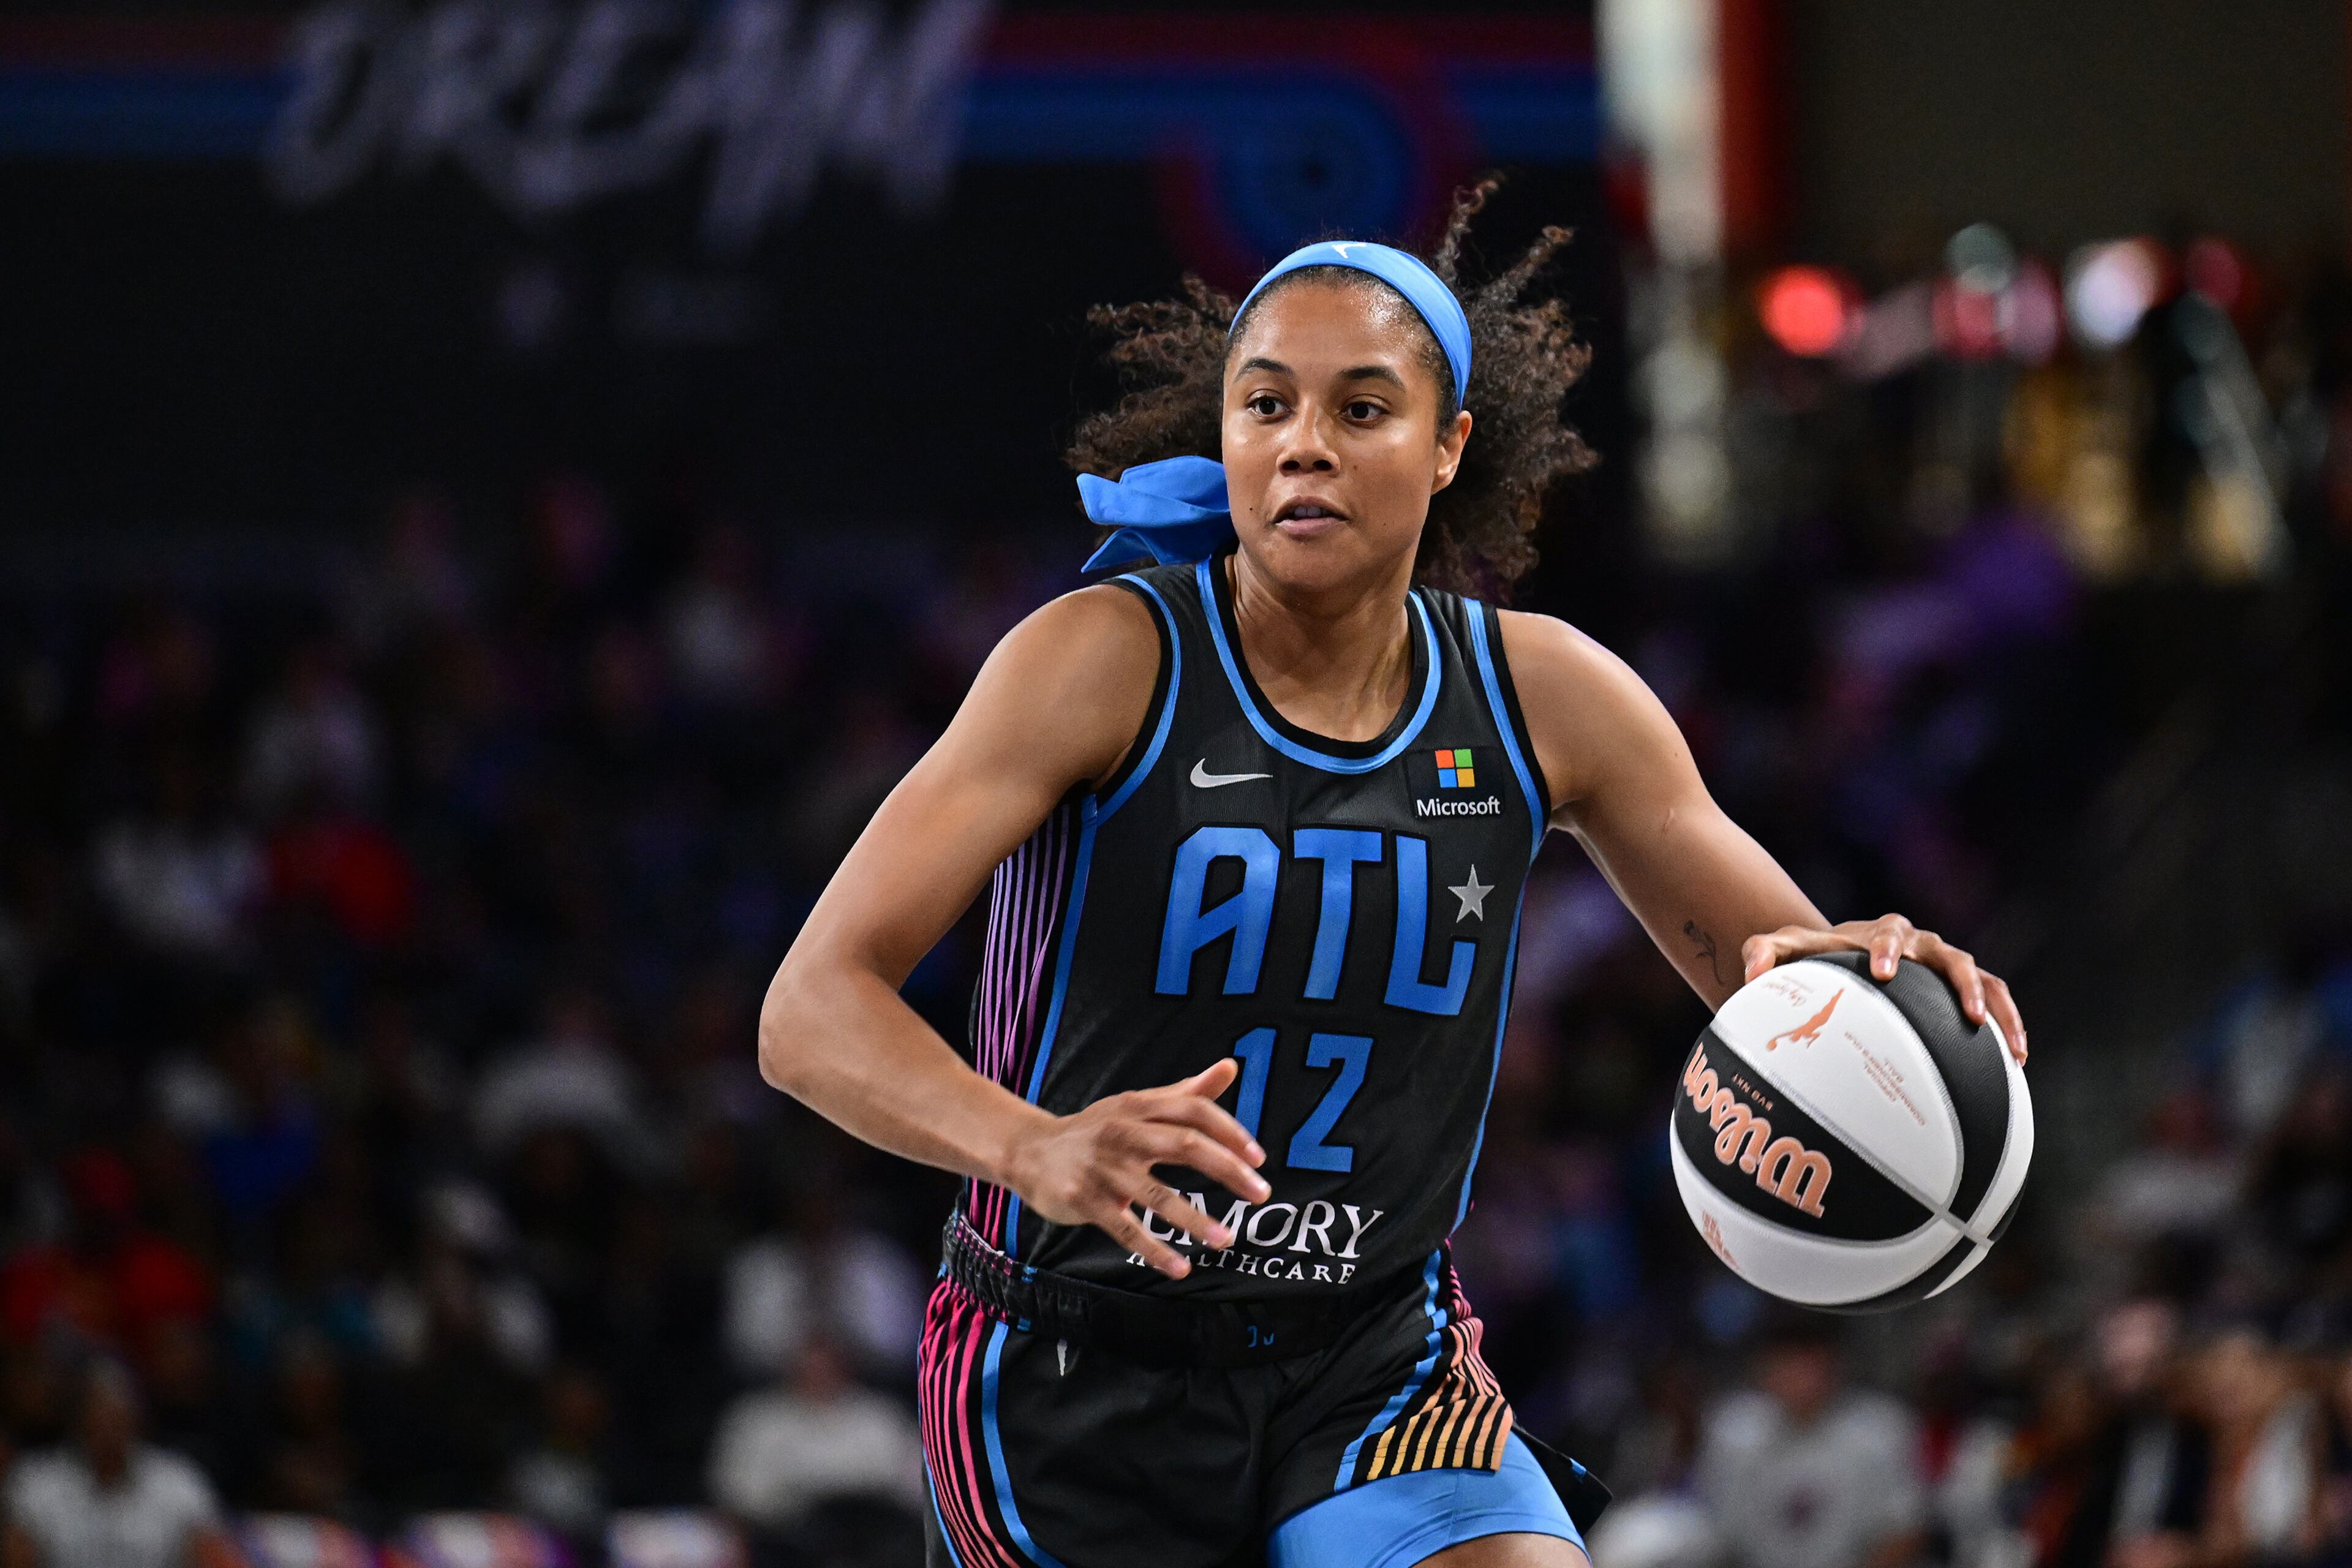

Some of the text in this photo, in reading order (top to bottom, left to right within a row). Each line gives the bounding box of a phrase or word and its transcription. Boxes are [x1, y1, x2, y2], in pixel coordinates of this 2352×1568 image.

[1416, 796, 1501, 817] Microsoft
[1155, 826, 1477, 1016] ATL
[1233, 1027, 1374, 1172] 12
[1683, 1041, 1832, 1219] Wilson
